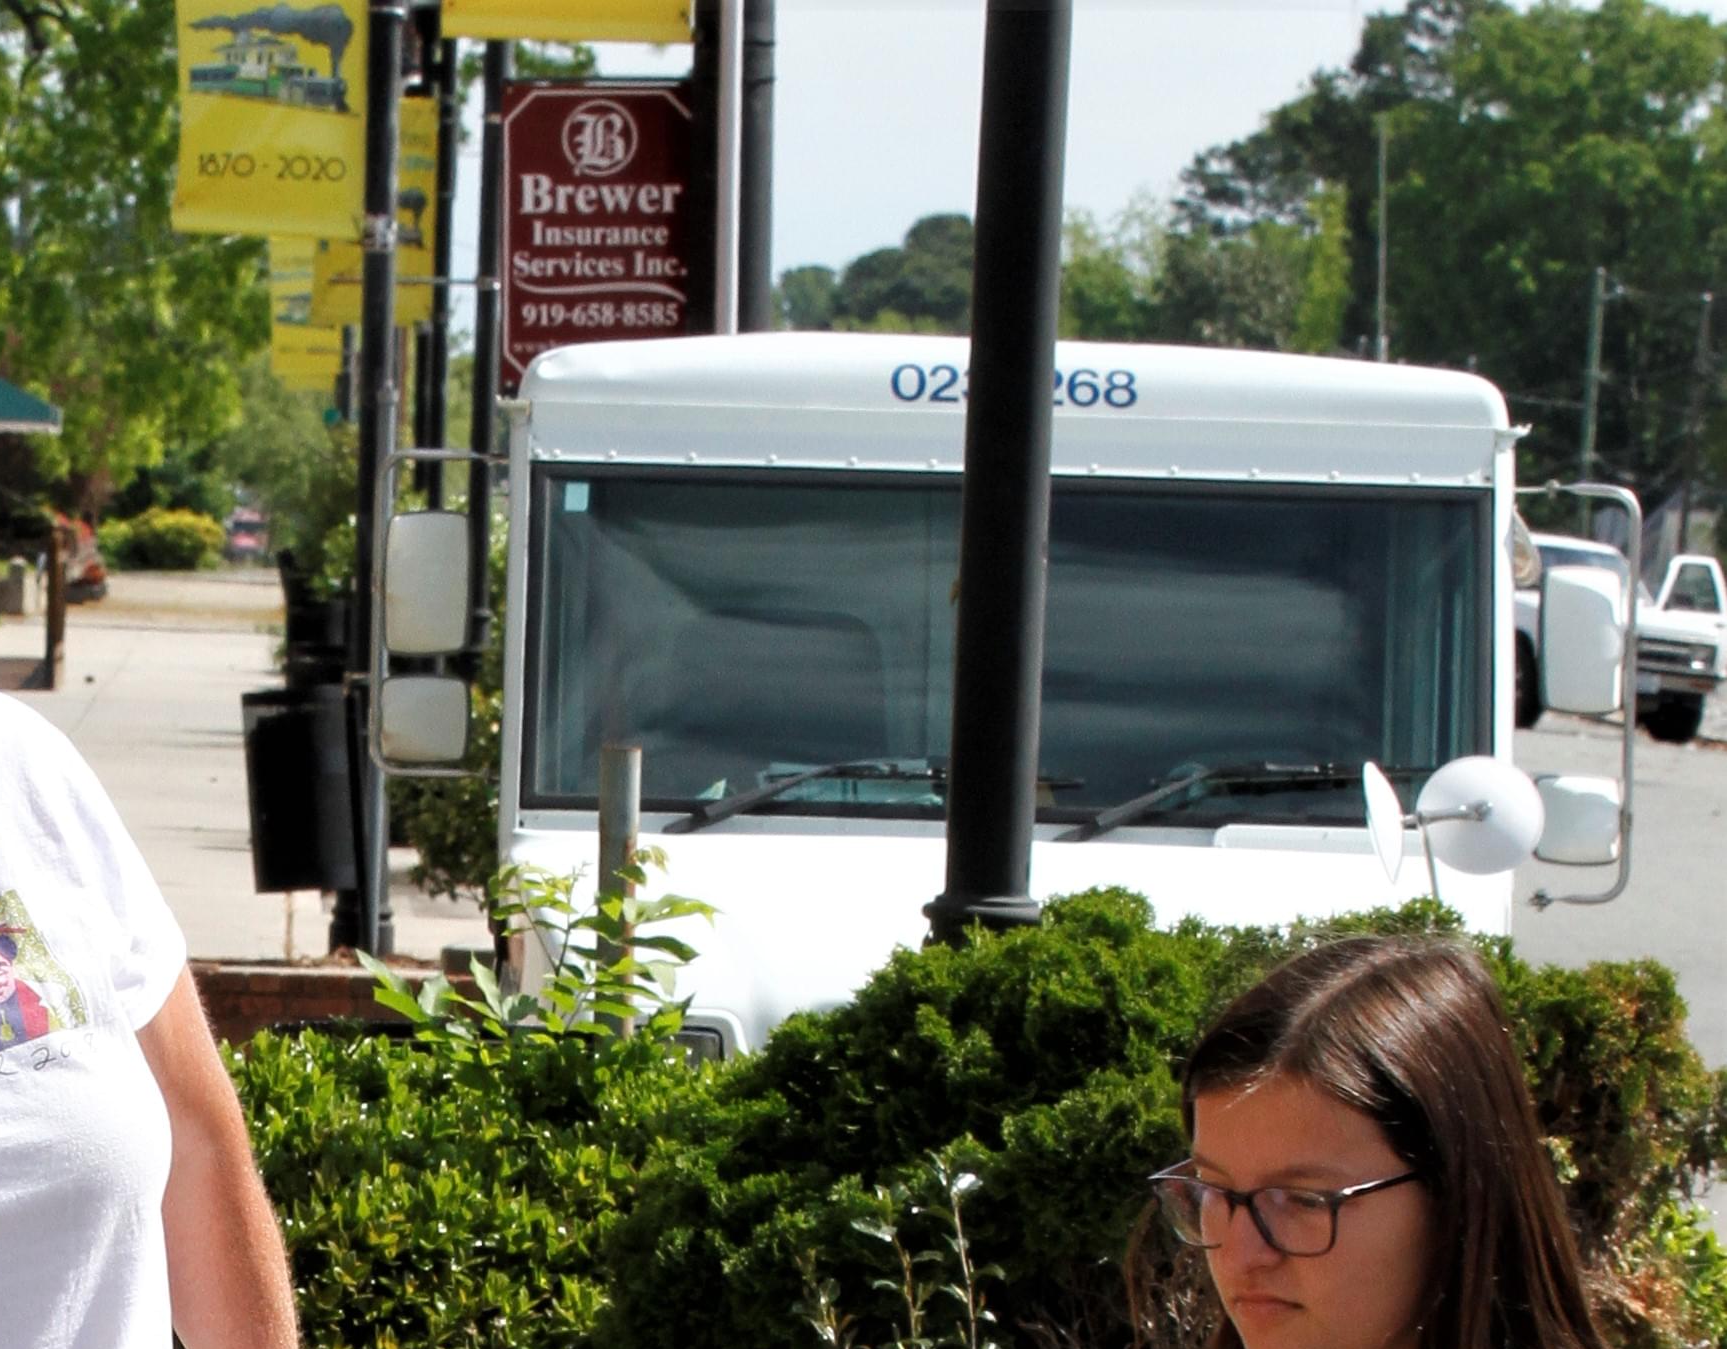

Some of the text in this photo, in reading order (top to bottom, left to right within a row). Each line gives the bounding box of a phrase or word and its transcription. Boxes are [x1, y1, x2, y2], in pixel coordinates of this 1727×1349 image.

[198, 152, 257, 178] 1870
[276, 155, 346, 182] 2020
[519, 173, 684, 215] Brewer
[532, 220, 670, 247] Insurance
[512, 250, 689, 278] Services Inc.
[521, 302, 680, 327] 919-658-8585
